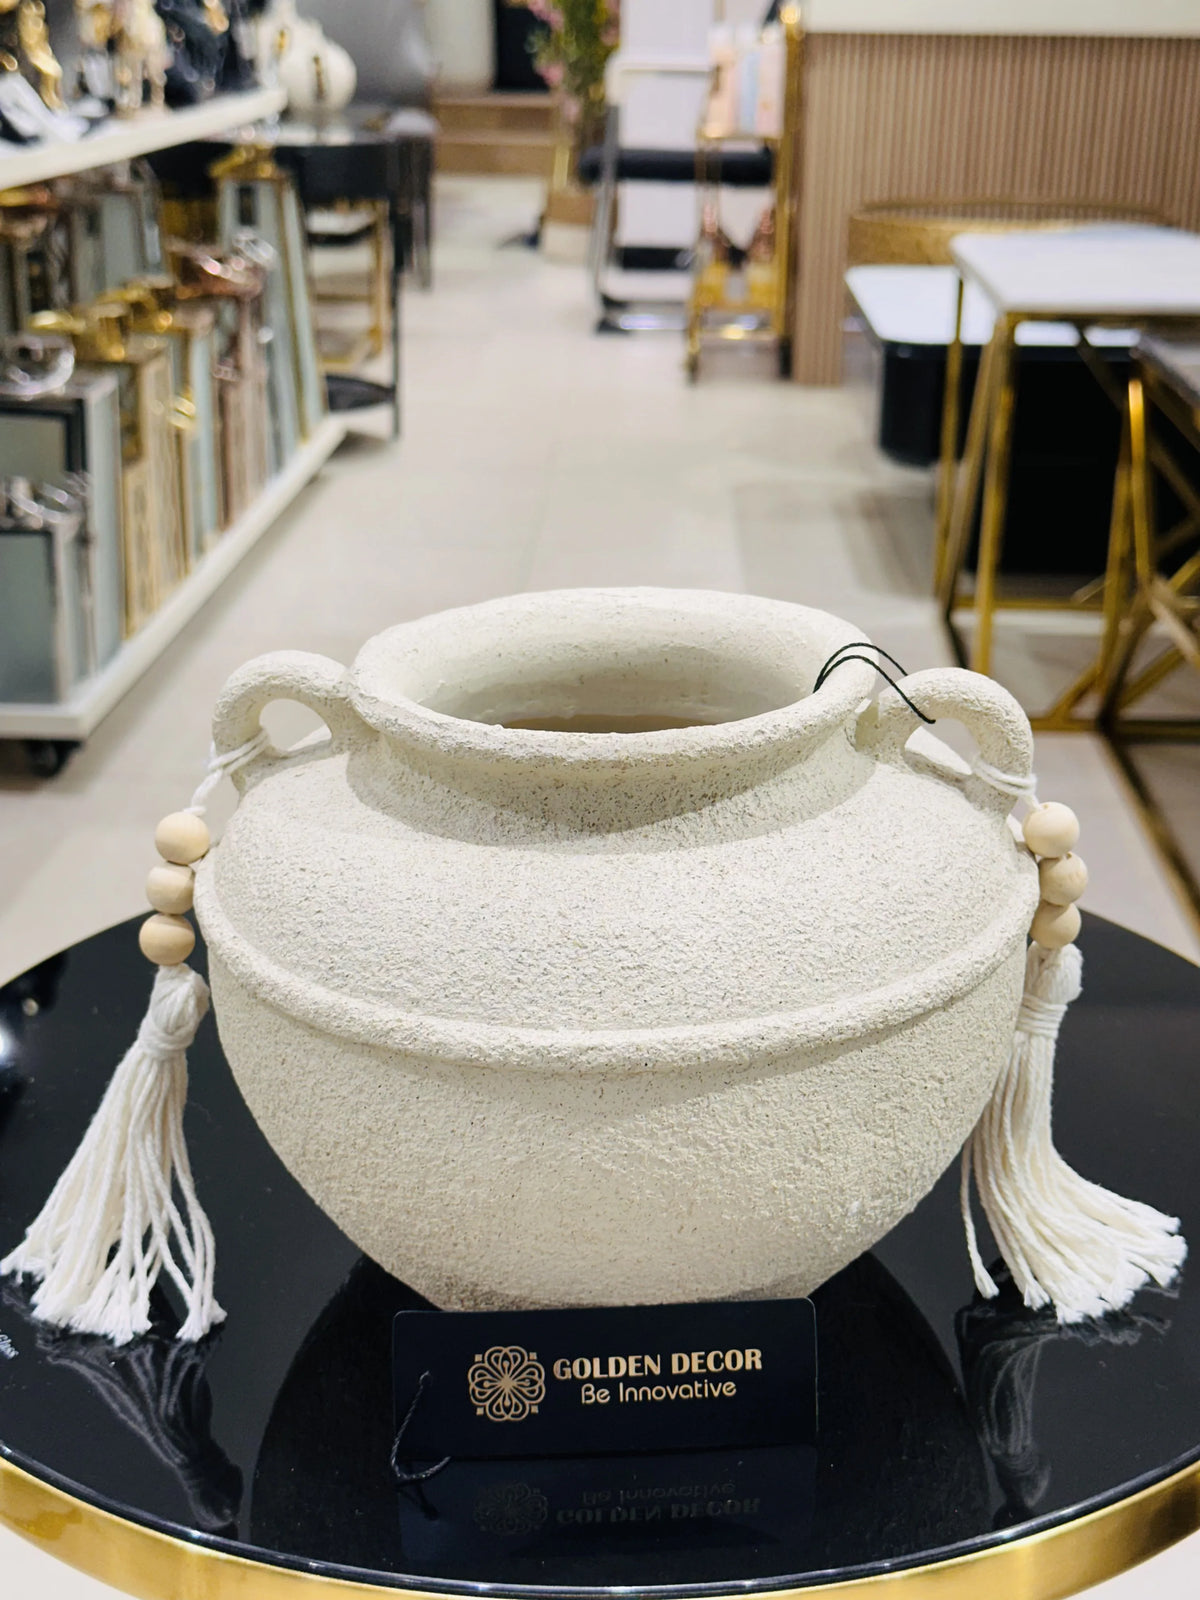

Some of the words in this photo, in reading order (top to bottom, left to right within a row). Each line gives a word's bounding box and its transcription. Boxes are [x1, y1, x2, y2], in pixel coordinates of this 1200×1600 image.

[553, 1354, 661, 1380] GOLDEN
[671, 1348, 763, 1375] DECOR
[581, 1383, 611, 1404] Be
[619, 1379, 737, 1402] Innovative
